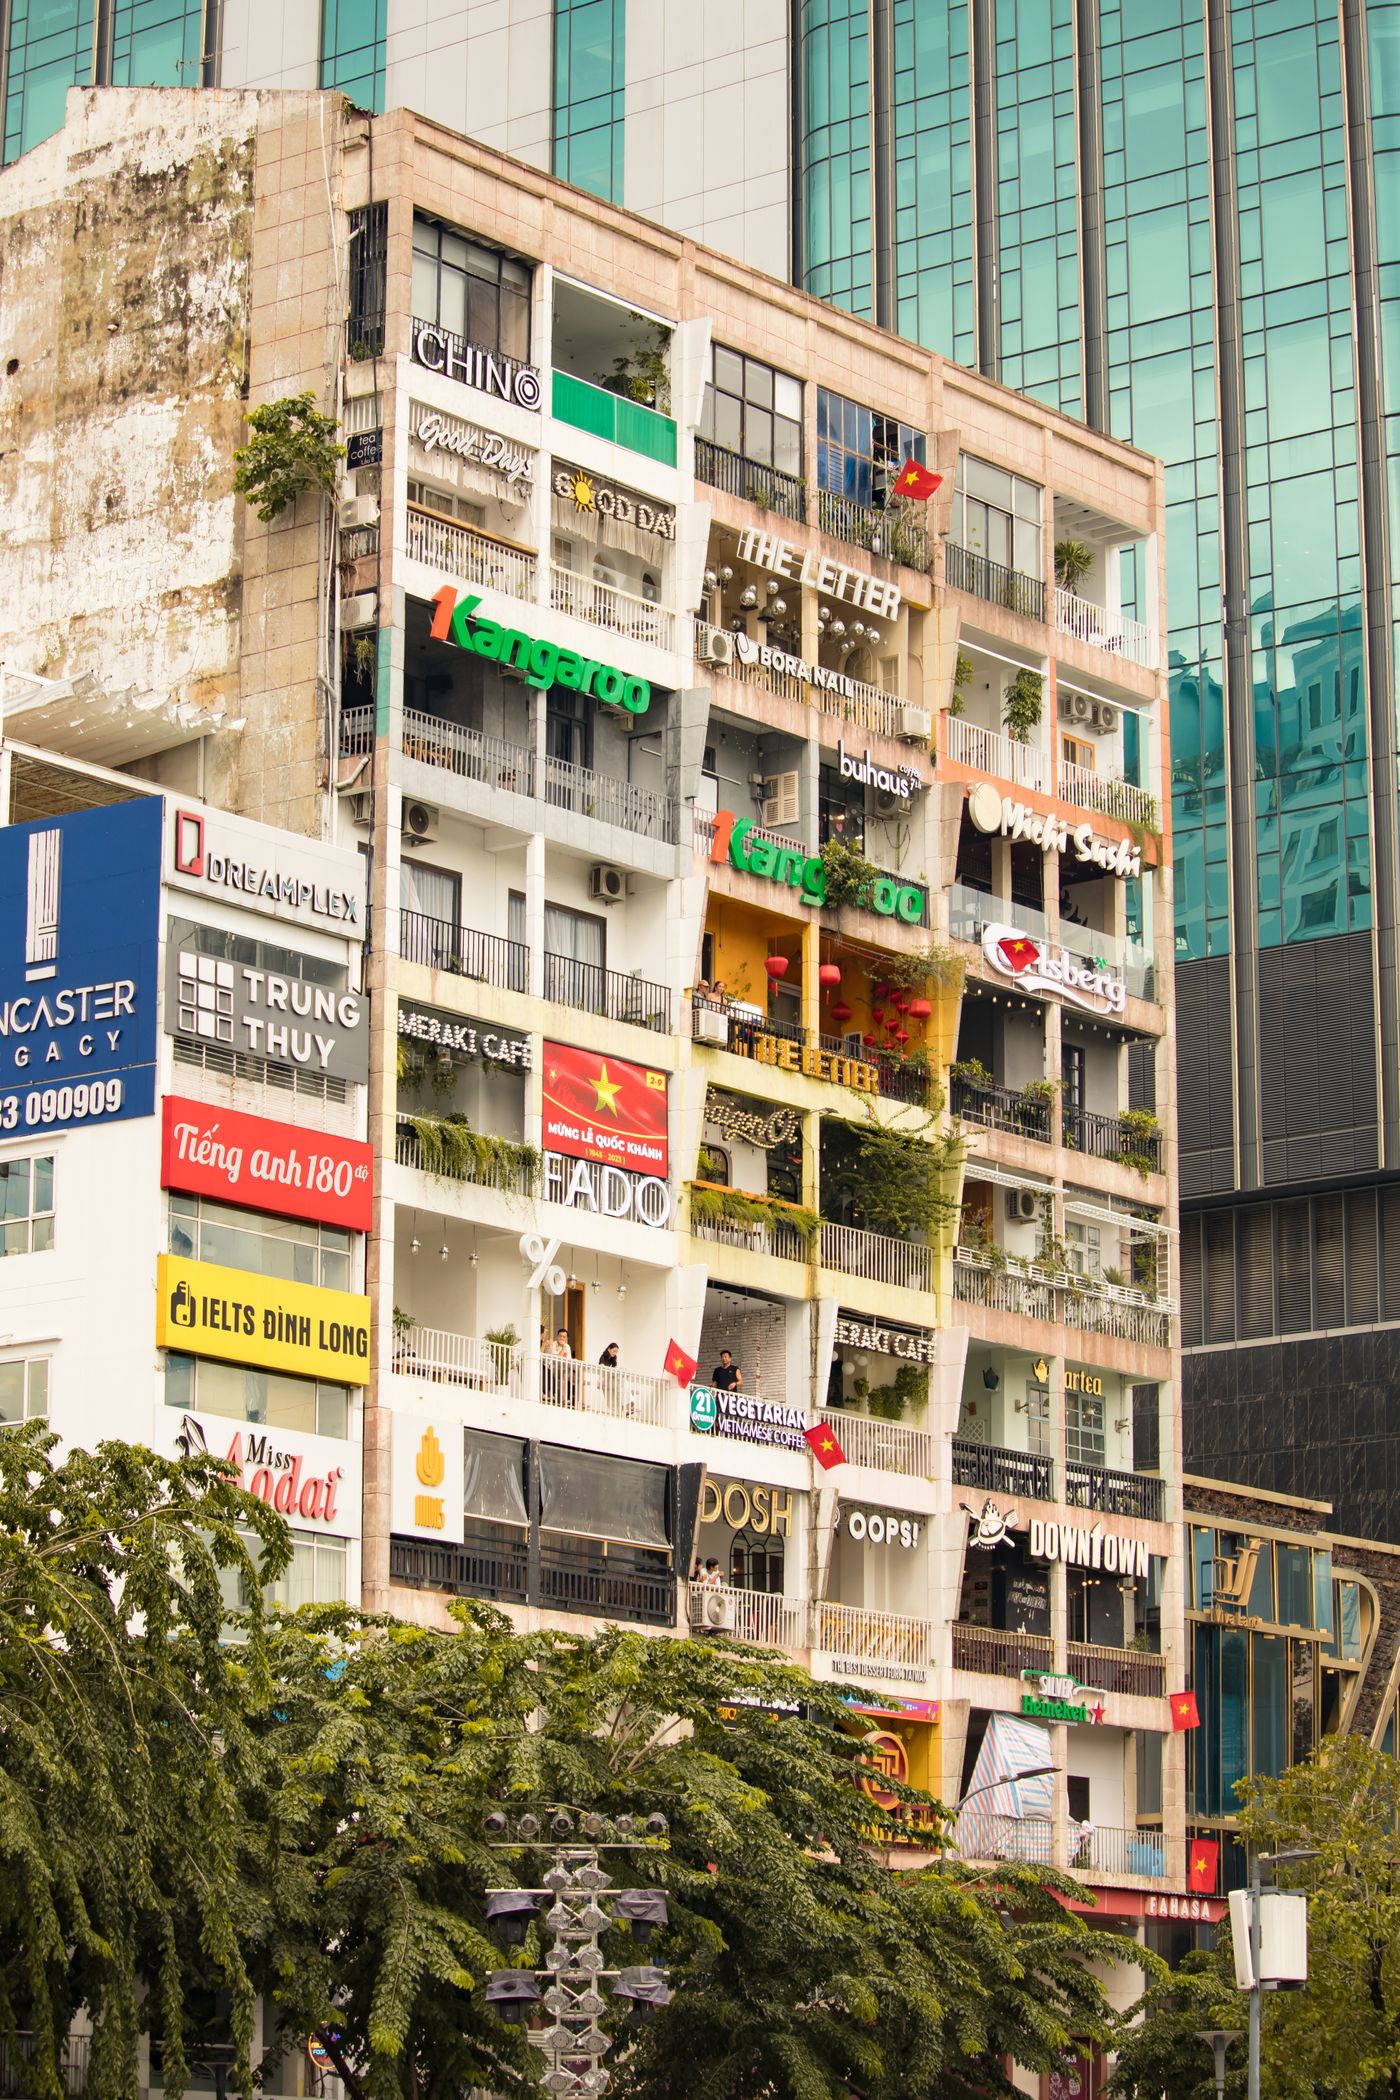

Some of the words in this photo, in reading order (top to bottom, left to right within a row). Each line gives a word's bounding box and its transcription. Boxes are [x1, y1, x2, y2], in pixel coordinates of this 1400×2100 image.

[416, 328, 543, 410] CHINO
[359, 434, 376, 446] tea
[417, 414, 478, 456] Good
[481, 434, 535, 483] Days
[741, 524, 795, 577] THE
[800, 549, 902, 622] LETTER
[760, 646, 811, 683] BORA
[1001, 797, 1068, 853] Michi
[1074, 823, 1141, 878] Sushi
[208, 852, 358, 923] DREAMPLEX
[243, 969, 361, 1028] TRUNG
[15, 1029, 121, 1068] GACY
[243, 1016, 336, 1068] THUY
[649, 1076, 663, 1087] 2-9
[802, 1046, 880, 1096] LETTER
[26, 1078, 122, 1125] 090909
[173, 1123, 243, 1183] Tiếng
[250, 1149, 302, 1187] anh
[306, 1155, 353, 1197] 180
[355, 1164, 369, 1182] độ
[548, 1122, 579, 1140] MỪNG
[581, 1127, 594, 1144] LỄ
[596, 1135, 625, 1152] QUỐC
[627, 1142, 663, 1160] KHÁNH
[544, 1151, 671, 1228] FADO
[202, 1296, 255, 1336] IELTS
[263, 1306, 311, 1347] ĐÌNH
[319, 1320, 368, 1358] LONG
[691, 1410, 715, 1423] Grams
[695, 1391, 711, 1413] 21
[717, 1393, 808, 1430] VEGETARIAN
[246, 1434, 292, 1469] Miss
[718, 1416, 772, 1441] VIETNAMESE
[774, 1431, 806, 1449] COFFEE
[219, 1431, 339, 1521] Aodai
[700, 1478, 793, 1537] DOSH
[849, 1511, 919, 1548] OOPS!
[1022, 1695, 1087, 1721] Heineken
[1039, 1675, 1074, 1699] SILVER
[1148, 1896, 1210, 1920] FAHASA
